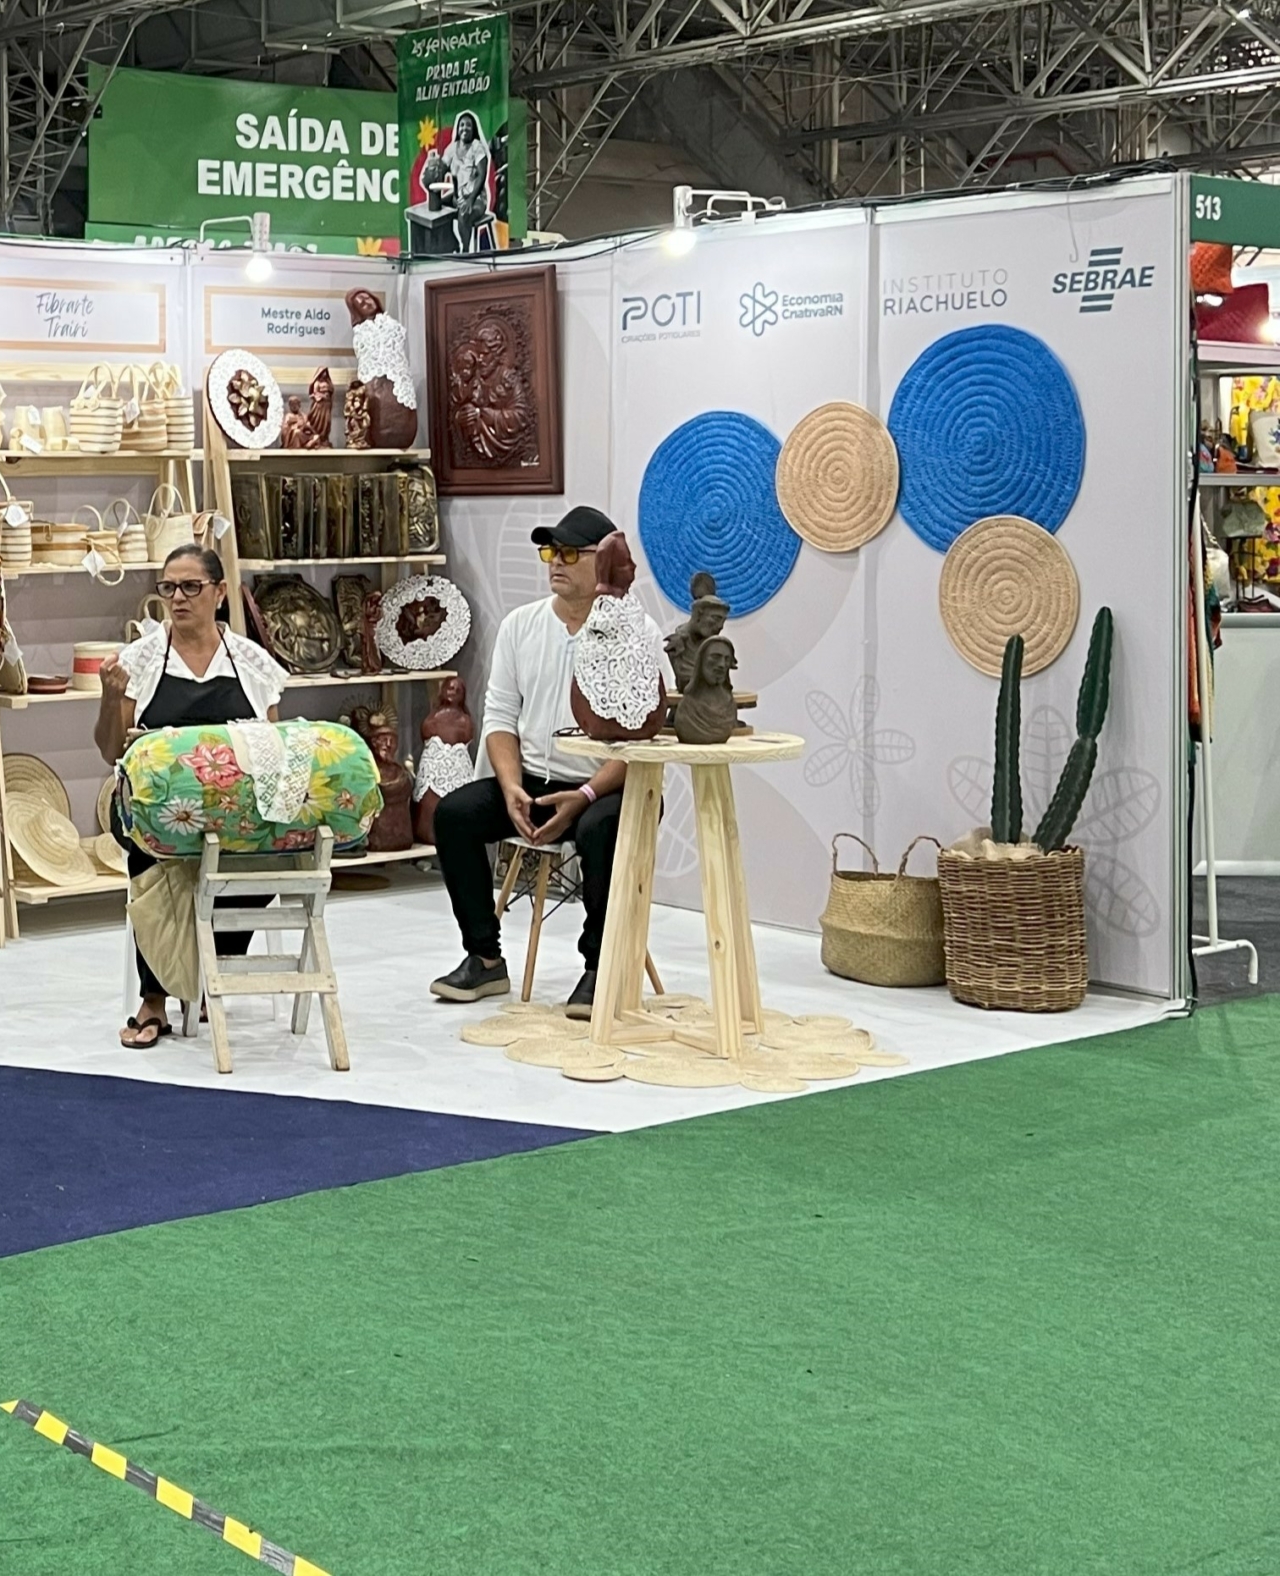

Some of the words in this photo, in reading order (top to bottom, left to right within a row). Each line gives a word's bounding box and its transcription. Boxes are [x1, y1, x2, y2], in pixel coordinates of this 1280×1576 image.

[426, 61, 460, 81] PRAÇA
[463, 58, 478, 76] DE
[235, 109, 350, 155] SAÍDA
[361, 122, 399, 156] DE
[1195, 194, 1221, 220] 513
[883, 268, 1009, 295] INSTITUTO
[1052, 266, 1155, 294] SEBRAE
[36, 292, 94, 317] Fibrarte
[622, 290, 701, 331] POTI
[782, 292, 844, 307] Economia
[883, 288, 1008, 316] RIACHUELO
[43, 314, 89, 338] Trairi
[261, 307, 302, 319] Mestre
[304, 308, 331, 321] Aldo
[267, 322, 326, 337] Rodrigues
